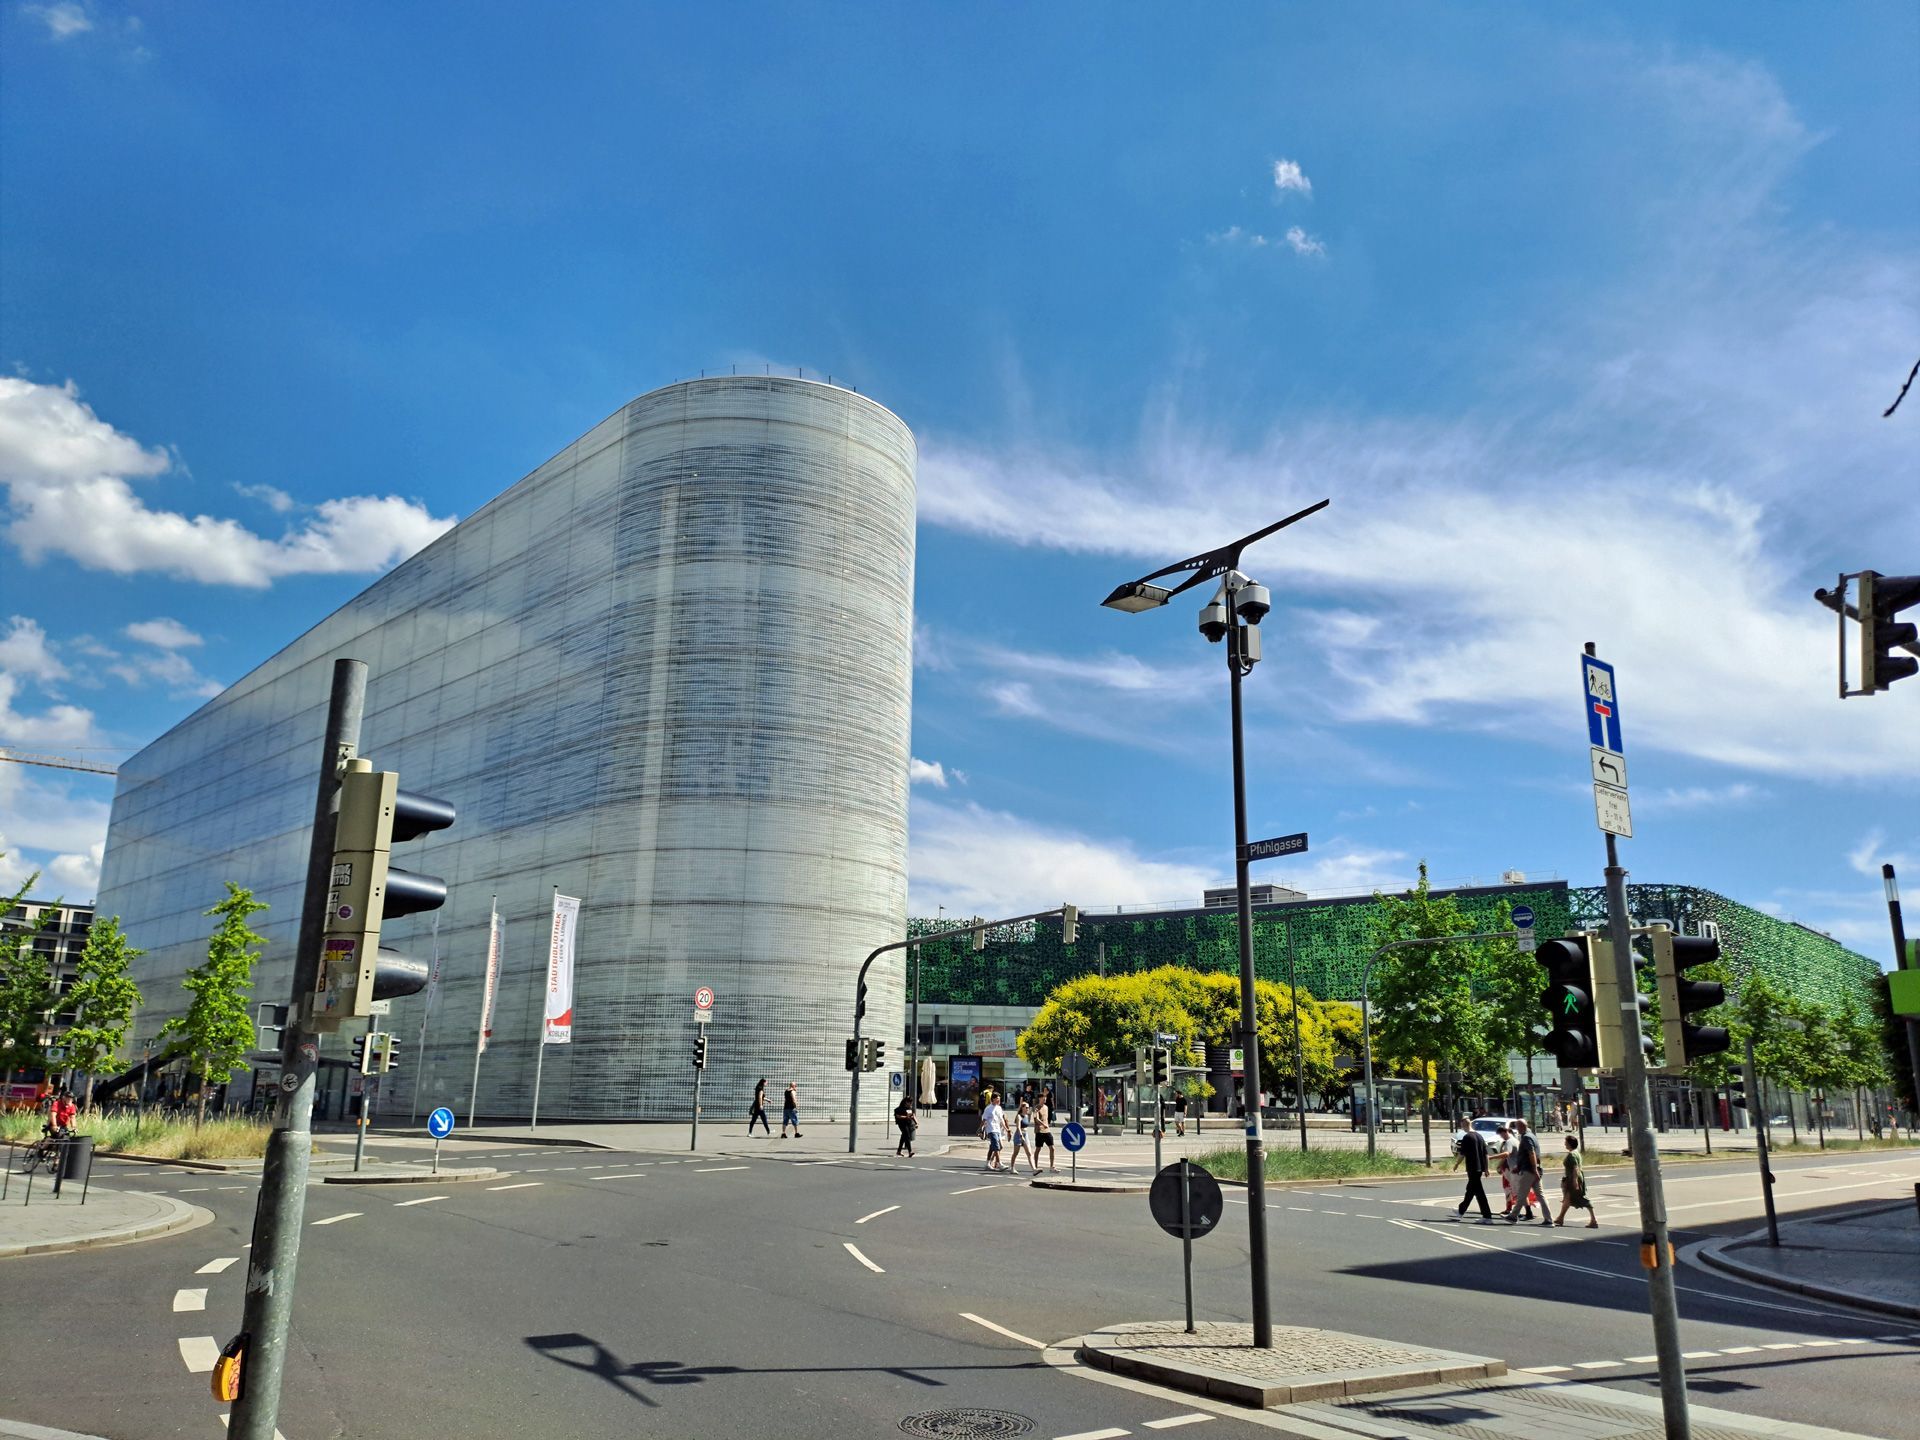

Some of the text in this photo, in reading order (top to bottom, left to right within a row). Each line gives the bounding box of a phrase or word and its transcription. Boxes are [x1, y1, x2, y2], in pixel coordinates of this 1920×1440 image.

[1250, 838, 1303, 856] Pfuhlgasse
[550, 912, 562, 993] STADTBIBLIOTHEK
[700, 992, 709, 1003] 20
